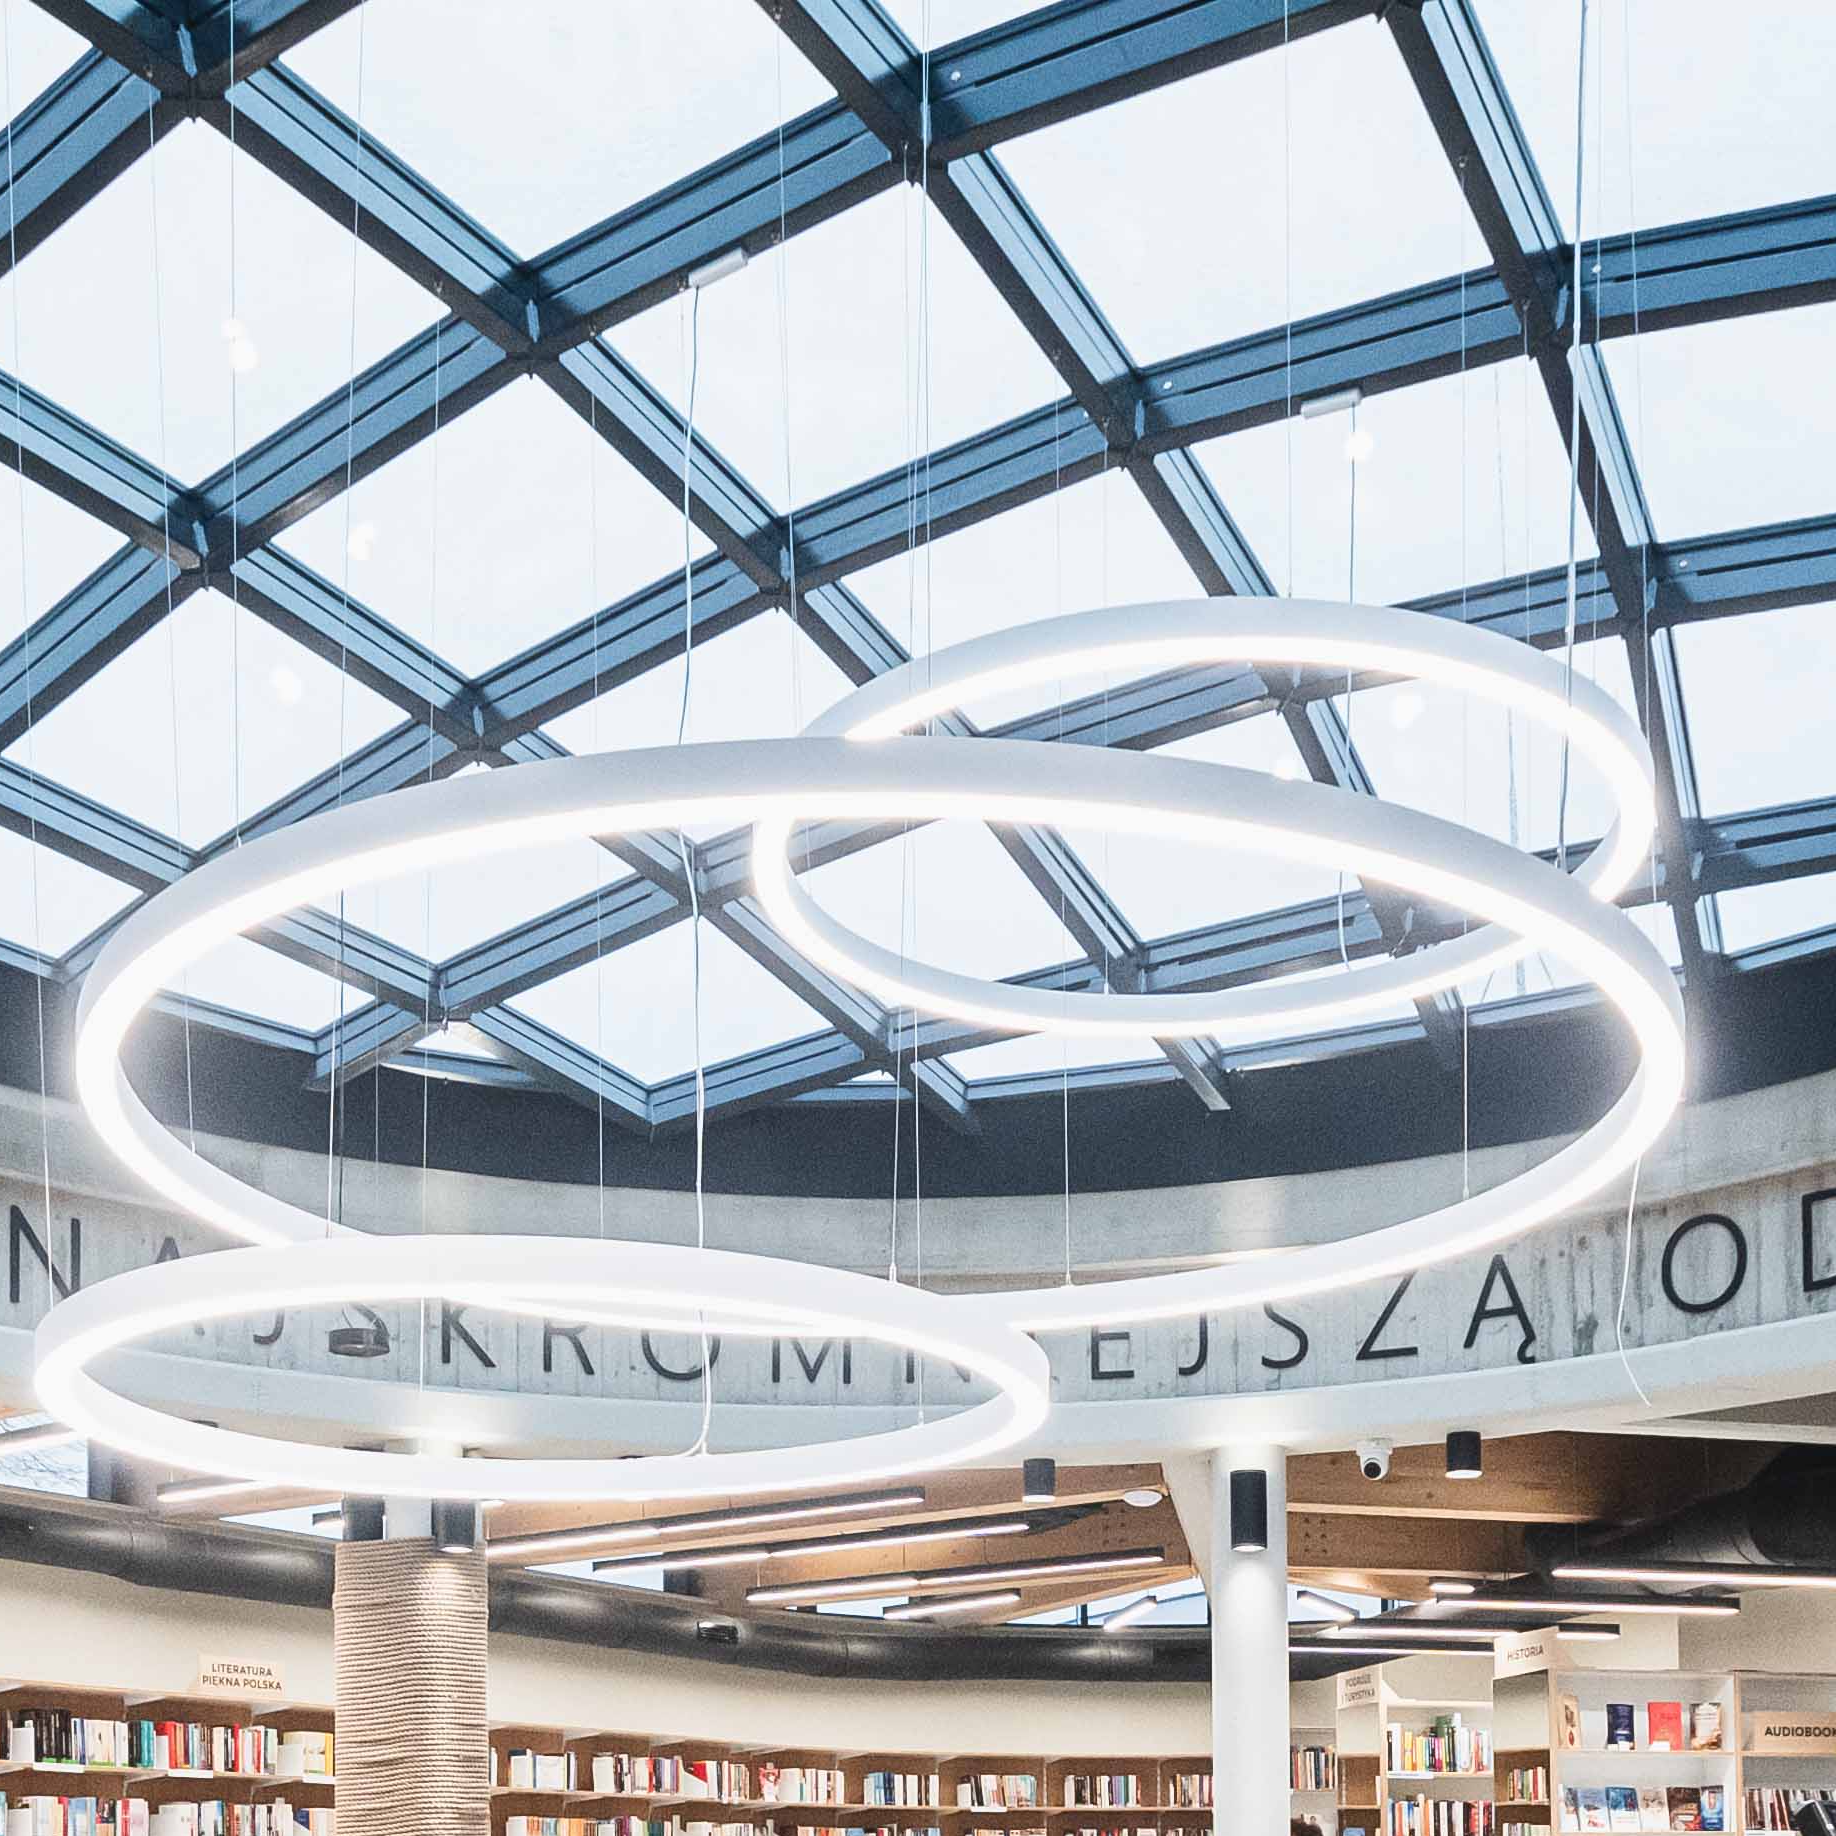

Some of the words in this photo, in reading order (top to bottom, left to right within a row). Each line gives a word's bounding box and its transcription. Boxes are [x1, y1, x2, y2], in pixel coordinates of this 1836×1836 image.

[1506, 1643, 1544, 1662] HISTORIA
[212, 1663, 273, 1677] LITERATURA
[202, 1675, 241, 1688] PIĘKNA
[243, 1678, 283, 1691] POLSKA
